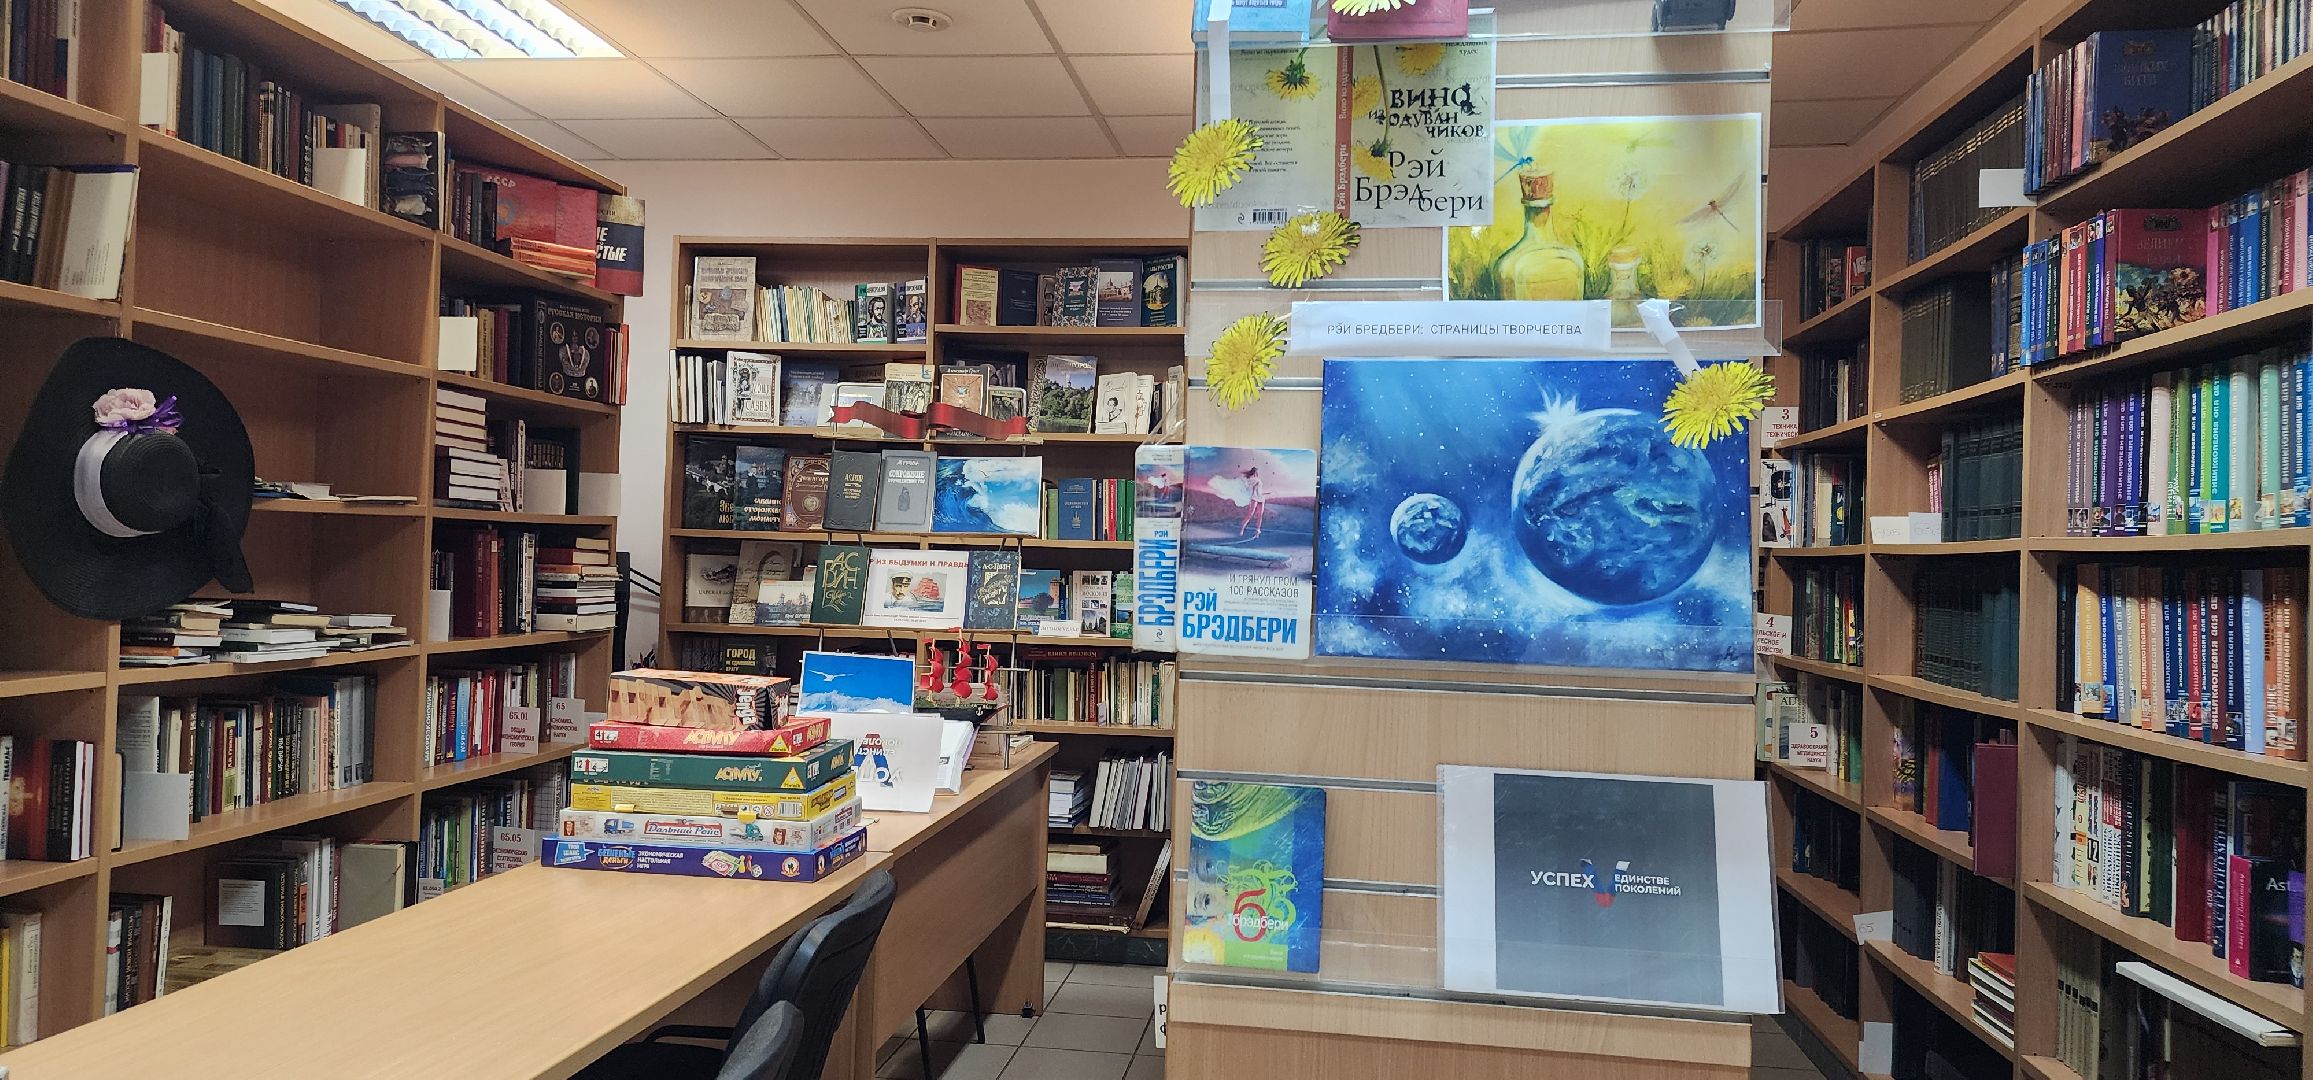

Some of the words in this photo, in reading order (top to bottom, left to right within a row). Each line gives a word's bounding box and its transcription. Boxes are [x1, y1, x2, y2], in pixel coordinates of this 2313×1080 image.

[1390, 87, 1472, 111] ВИНО
[1389, 109, 1459, 129] ОДУВАН
[1426, 124, 1485, 138] ЧИКОВ
[1388, 147, 1446, 179] Рэй
[1355, 176, 1426, 210] Брэд
[1418, 188, 1485, 219] бери
[1430, 324, 1500, 336] СТРАНИЦЫ
[1502, 324, 1583, 335] ТВОРЧЕСТВА
[1782, 408, 1790, 420] 3
[1138, 539, 1178, 627] БРЭДБЕРИ
[1229, 586, 1244, 596] 100
[1246, 586, 1299, 598] РАССКАЗОВ
[1183, 587, 1218, 612] РЭЙ
[1765, 616, 1775, 628] 4
[2210, 613, 2219, 637] ДЛЯ
[1182, 614, 1298, 645] БРЭДБЕРИ
[726, 649, 756, 660] ГОРОД
[2210, 640, 2219, 731] ЭНЦИКЛОПЕДИЯ
[556, 702, 565, 710] 65
[508, 711, 528, 721] 65.01
[1810, 727, 1818, 739] 5
[575, 760, 584, 771] 12
[500, 833, 522, 843] 65.05
[1530, 870, 1595, 891] УСПЕХ
[1614, 875, 1670, 888] ЕДИНСТВЕ
[1615, 884, 1682, 897] ПОКОЛЕНИЙ
